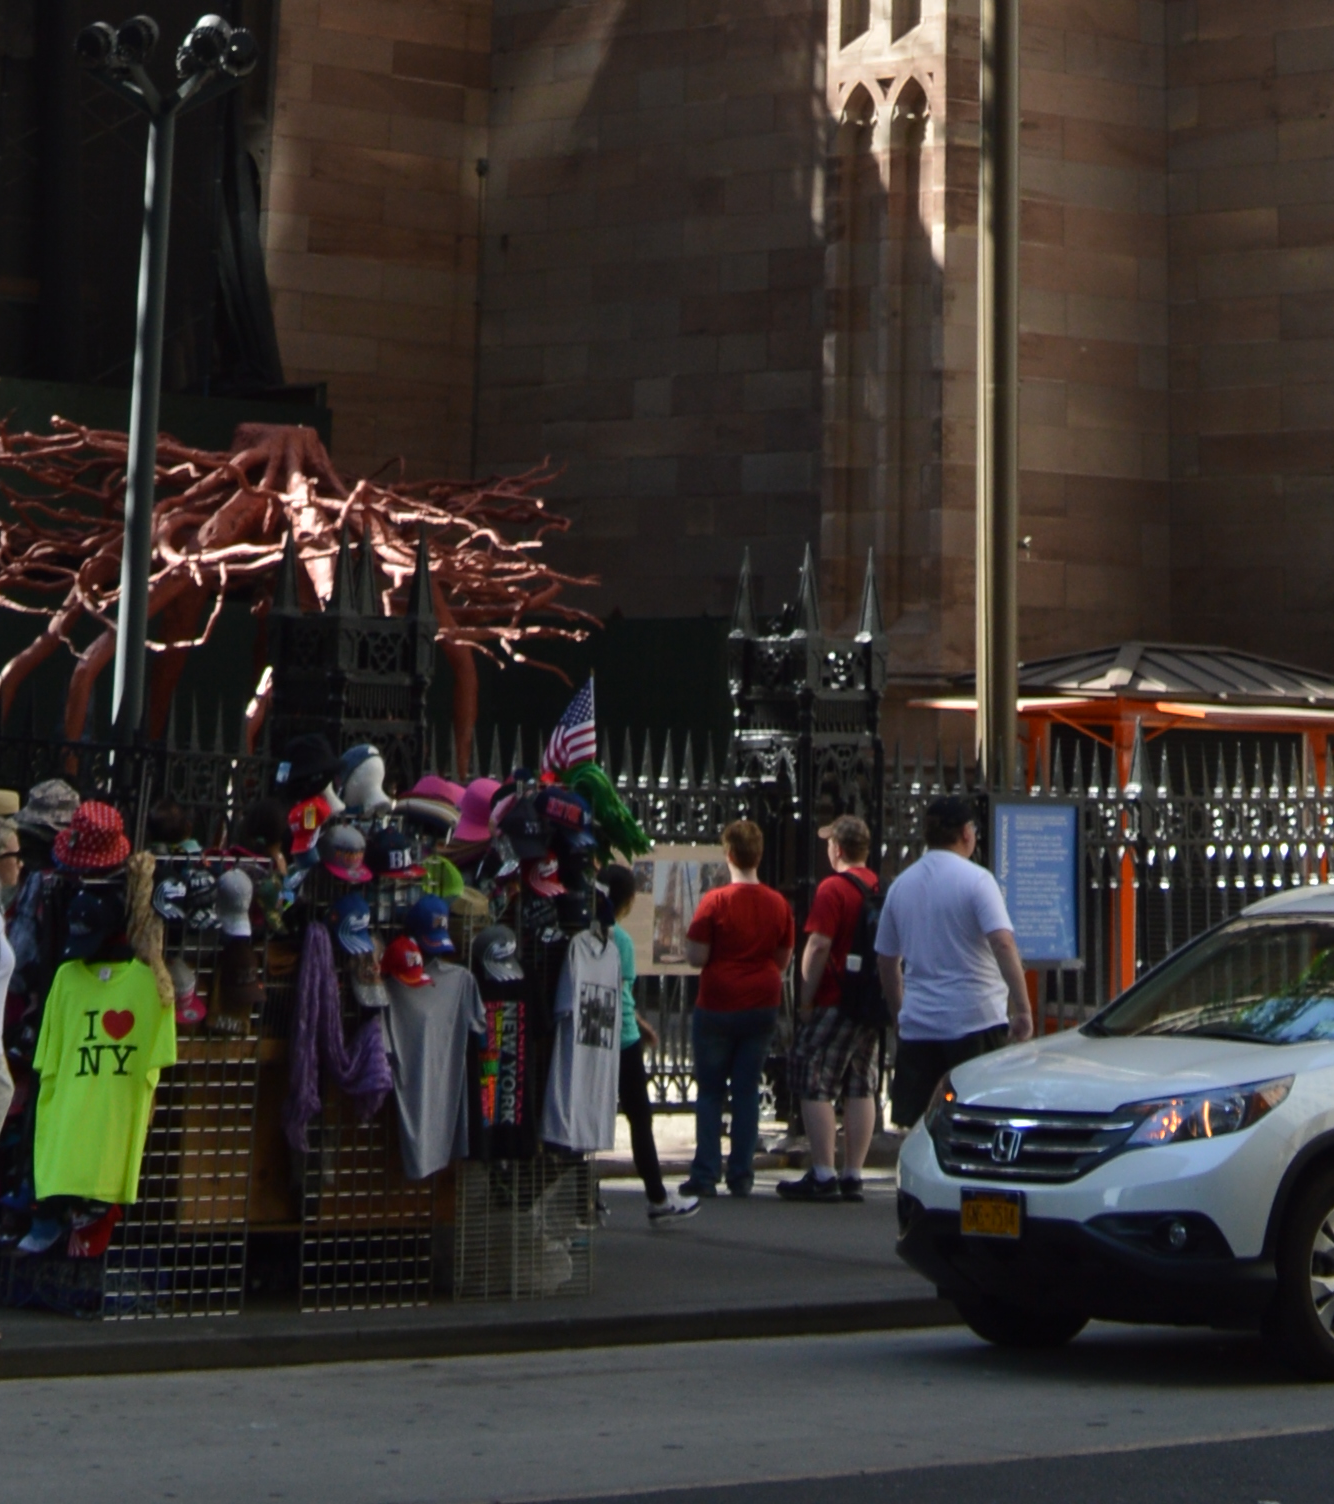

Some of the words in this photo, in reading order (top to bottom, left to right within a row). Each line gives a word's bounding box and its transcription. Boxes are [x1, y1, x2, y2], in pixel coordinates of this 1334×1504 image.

[83, 1010, 100, 1042] I
[500, 1001, 518, 1056] NEW
[75, 1044, 138, 1077] NY
[515, 1001, 526, 1125] MANHATTAN
[500, 1061, 517, 1124] YORK
